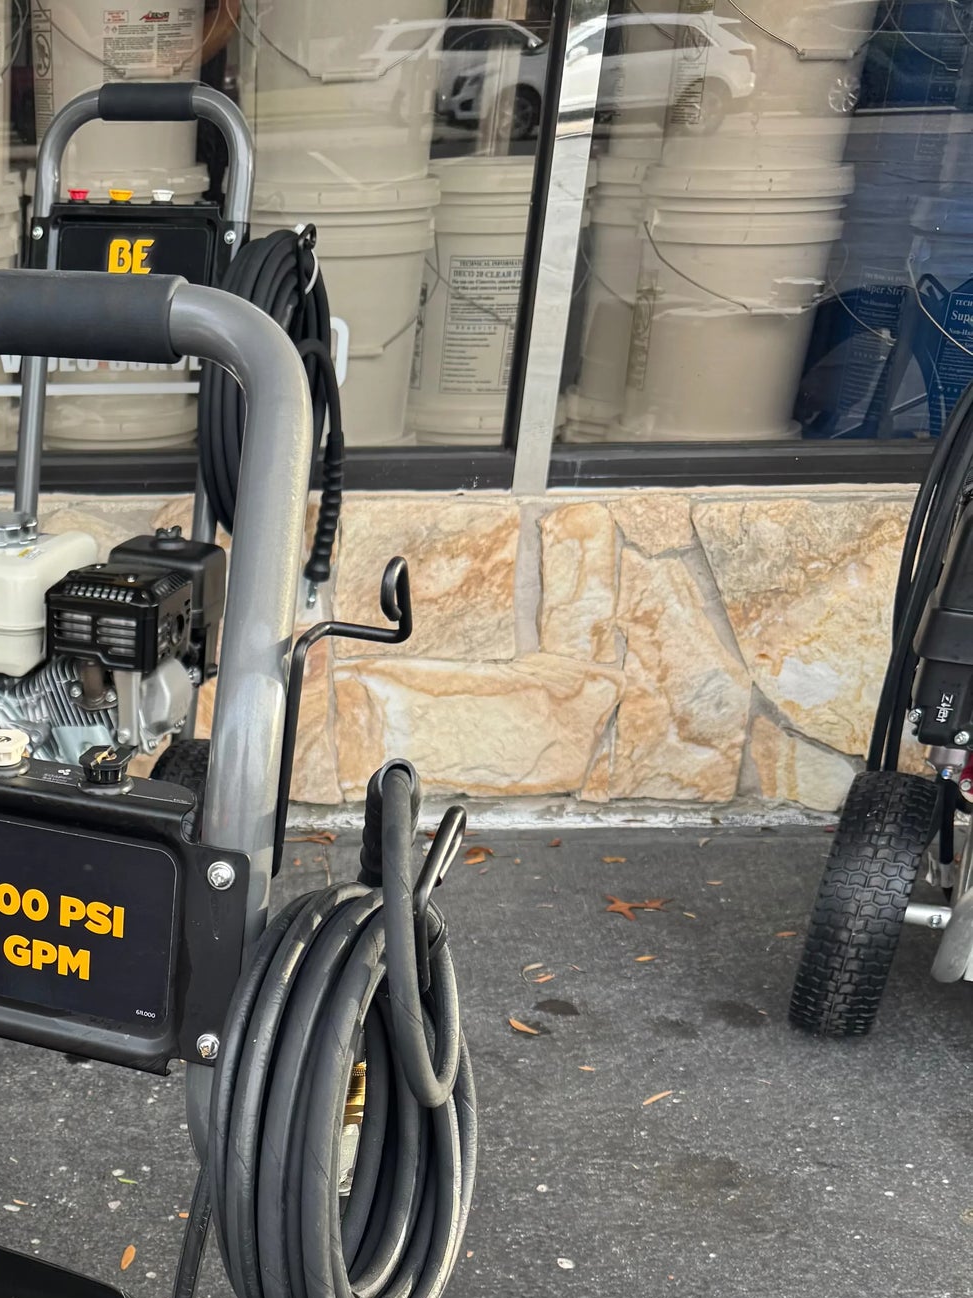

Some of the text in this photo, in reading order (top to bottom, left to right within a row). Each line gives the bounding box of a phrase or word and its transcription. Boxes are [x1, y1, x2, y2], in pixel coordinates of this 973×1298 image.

[108, 239, 155, 275] BE
[59, 895, 125, 939] PSI
[2, 934, 92, 982] GPM
